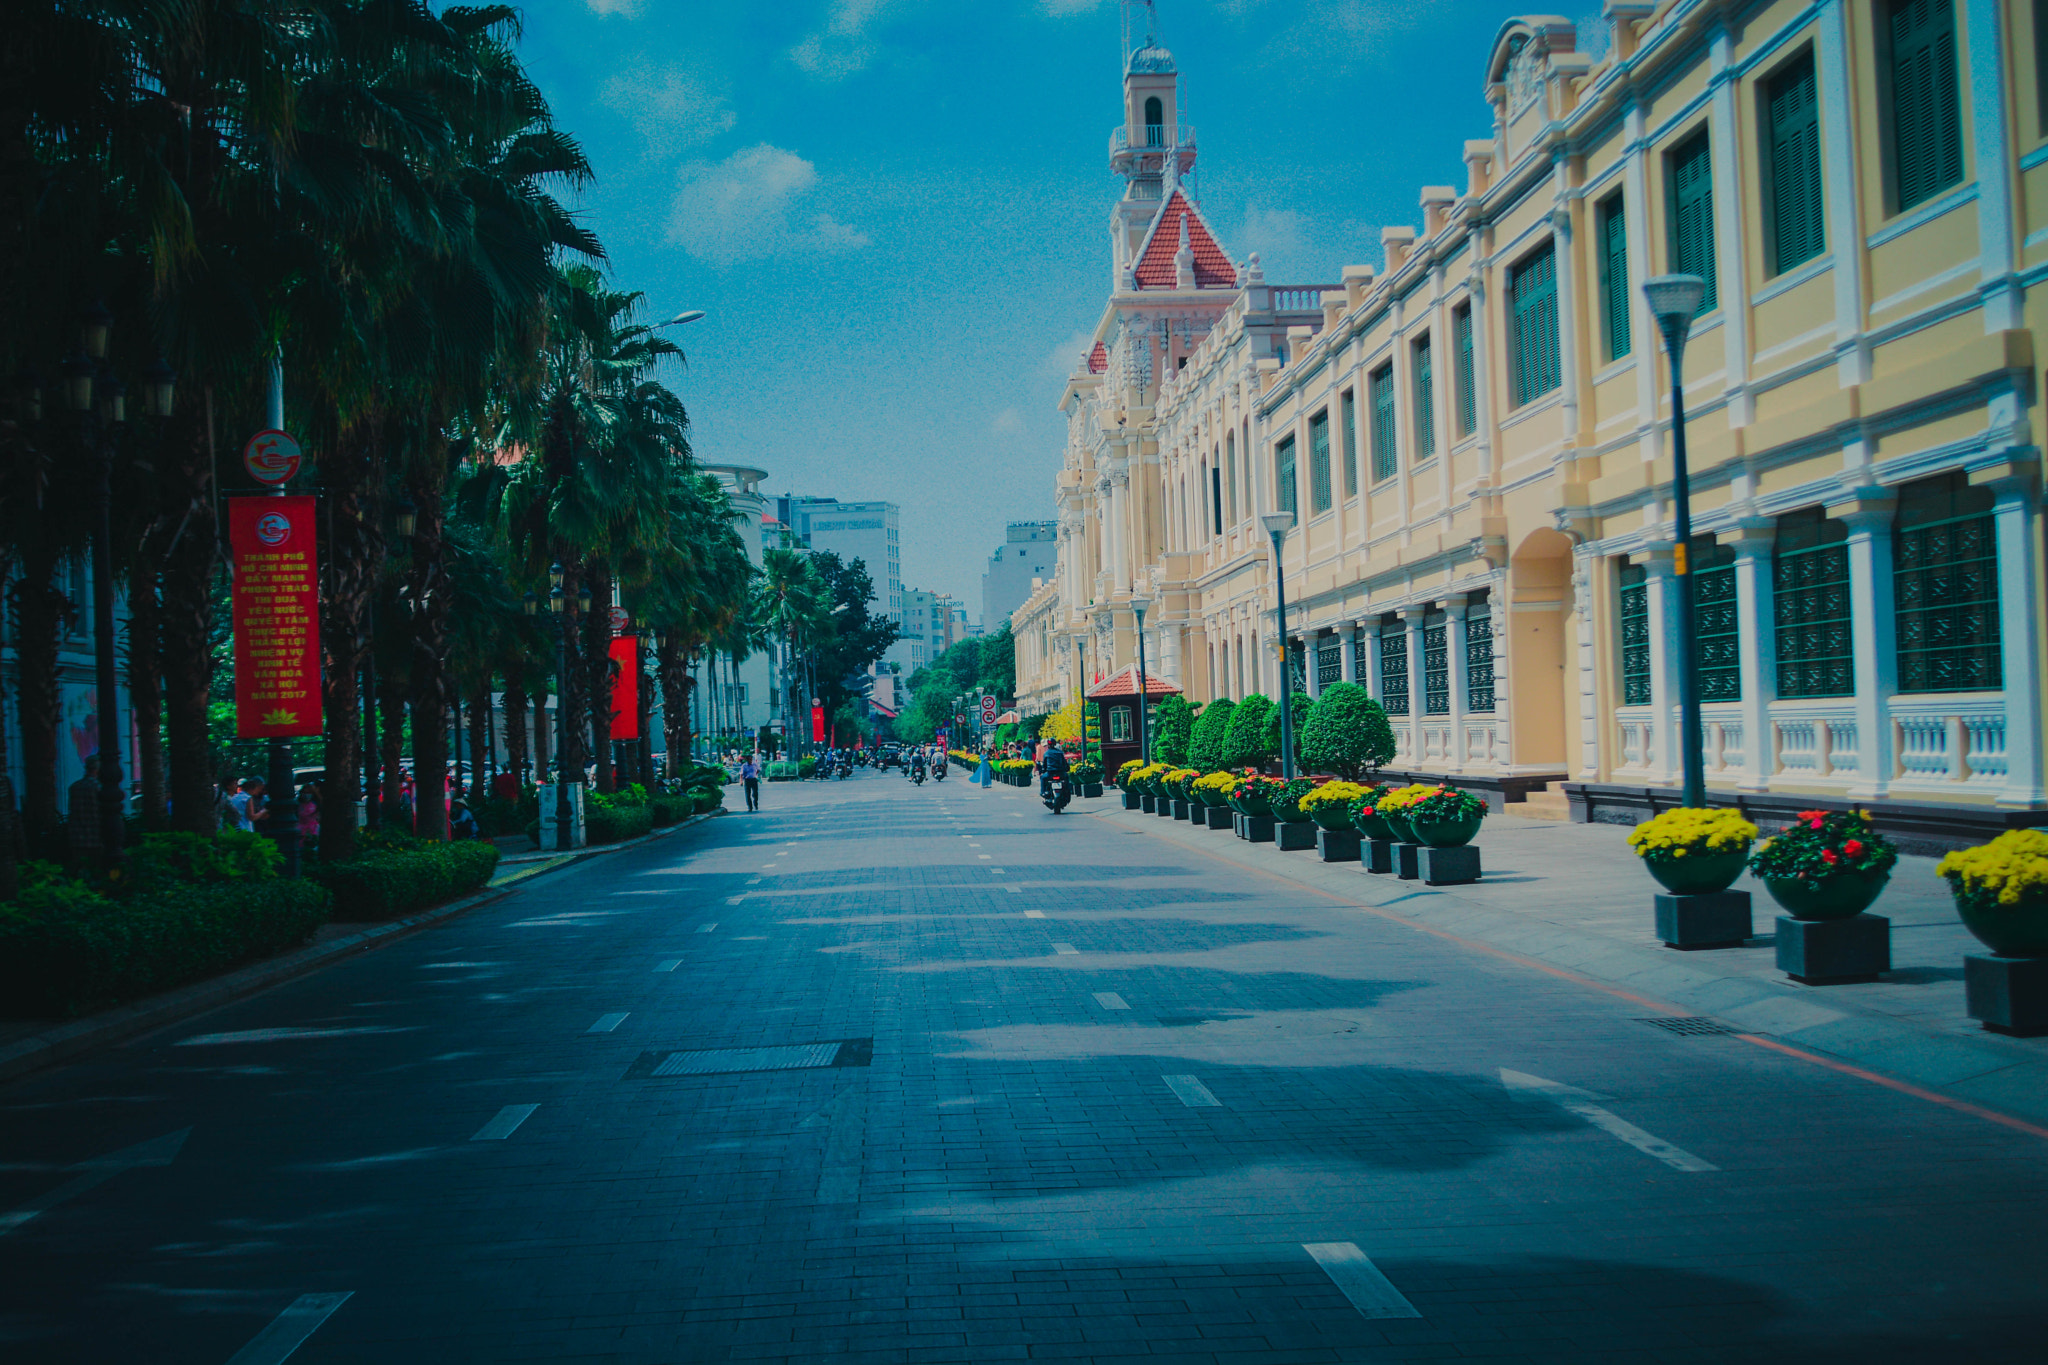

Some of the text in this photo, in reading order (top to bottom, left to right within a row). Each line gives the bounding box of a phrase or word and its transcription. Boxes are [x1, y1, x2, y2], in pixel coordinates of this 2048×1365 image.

[244, 551, 304, 561] THÀNH PHỐ
[241, 564, 255, 572] HỒ
[260, 563, 277, 572] CHÍ
[272, 574, 305, 583] MẠNH
[240, 584, 310, 594] PHONG TRÀO
[248, 605, 304, 614] YÊU NƯỚC
[244, 615, 310, 626] QUYẾT TÂM
[279, 626, 306, 635] HIỆN
[288, 638, 306, 646] LỢI
[289, 648, 304, 657] VỤ
[287, 657, 301, 666] TẾ
[260, 680, 298, 689] XÃ HỘI
[251, 691, 307, 700] NĂM 2017
